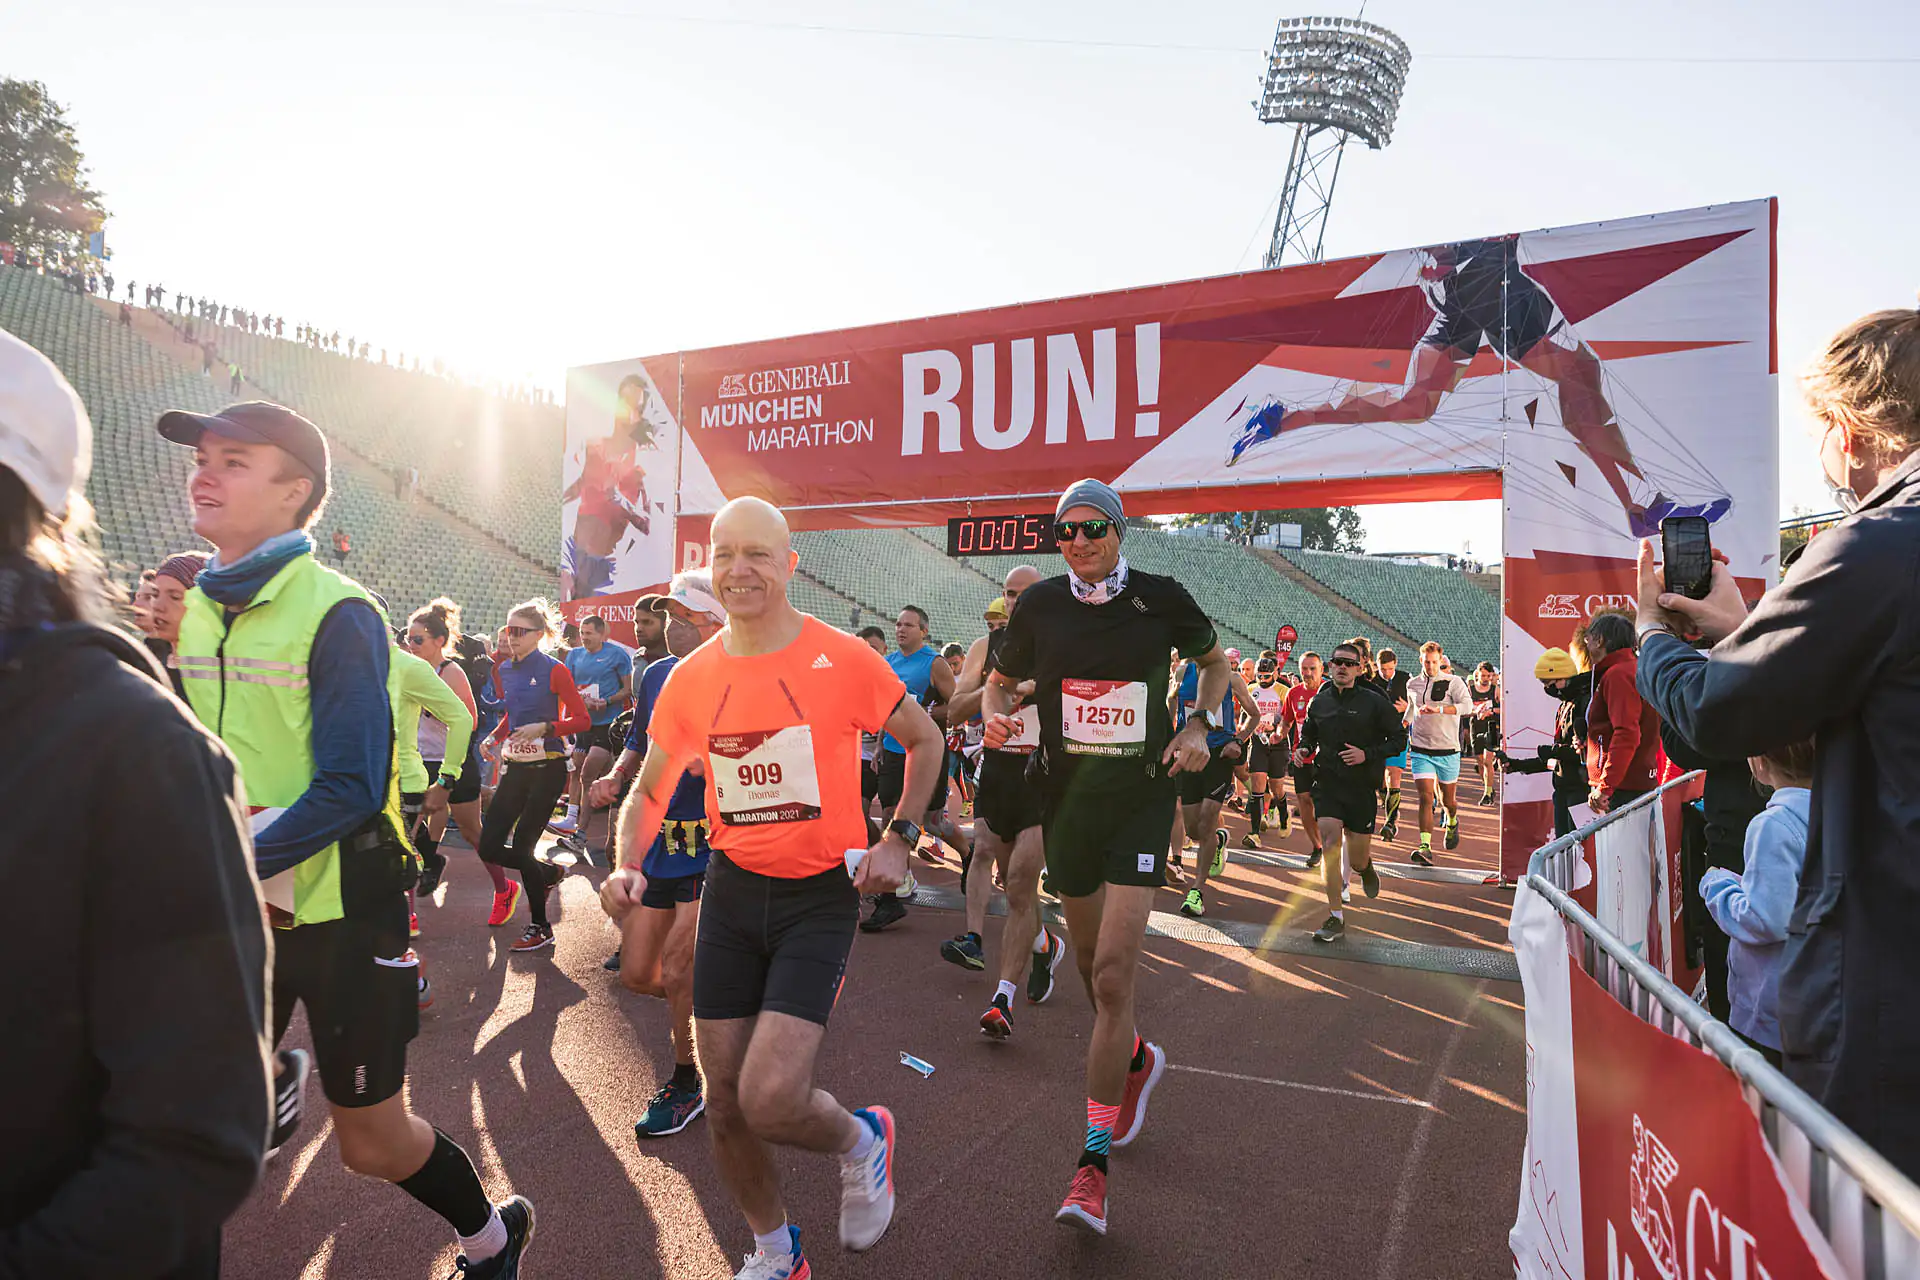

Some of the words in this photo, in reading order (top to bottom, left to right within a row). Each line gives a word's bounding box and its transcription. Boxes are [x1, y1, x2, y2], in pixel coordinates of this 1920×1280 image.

[749, 360, 851, 395] GENERALI
[901, 322, 1161, 456] RUN!
[700, 394, 822, 428] MÜNCHEN
[747, 418, 874, 452] MARATHON
[958, 519, 1060, 552] 00:05:
[597, 604, 636, 622] GENE
[1277, 642, 1292, 652] 1:45
[1075, 705, 1136, 727] 12570
[1063, 721, 1070, 731] B
[1092, 727, 1115, 738] Holger
[1066, 743, 1123, 755] HALBMARATHON
[738, 762, 782, 787] 909
[717, 786, 724, 798] B
[747, 788, 781, 800] Thomas
[732, 811, 779, 823] MARATHON
[779, 809, 800, 820] 2021
